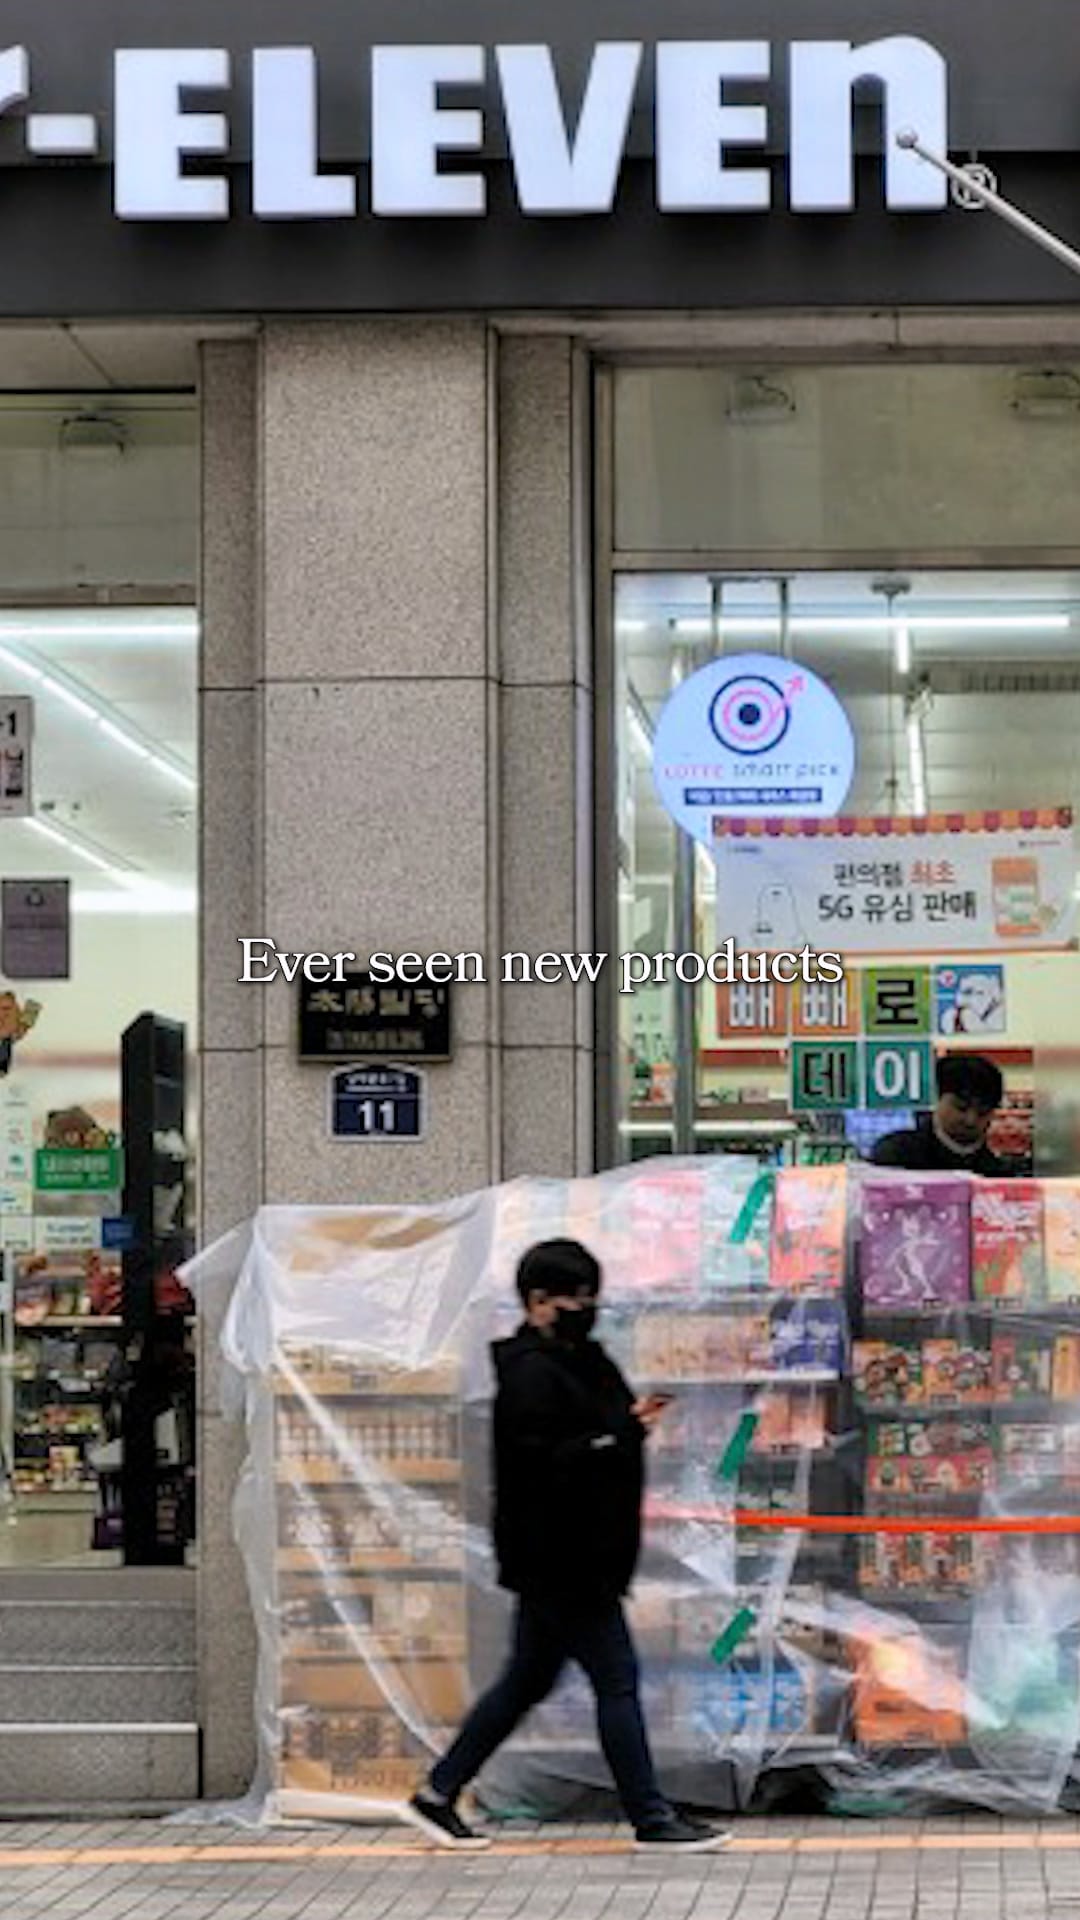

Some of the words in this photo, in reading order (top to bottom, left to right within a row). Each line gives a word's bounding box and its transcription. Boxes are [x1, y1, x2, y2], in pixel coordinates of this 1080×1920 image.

[833, 860, 903, 888] 편의점
[909, 858, 957, 886] 최초
[818, 893, 854, 923] 5G
[861, 892, 913, 924] 유심
[921, 889, 978, 923] 판매
[803, 1050, 921, 1101] 데이
[359, 1100, 395, 1132] 11
